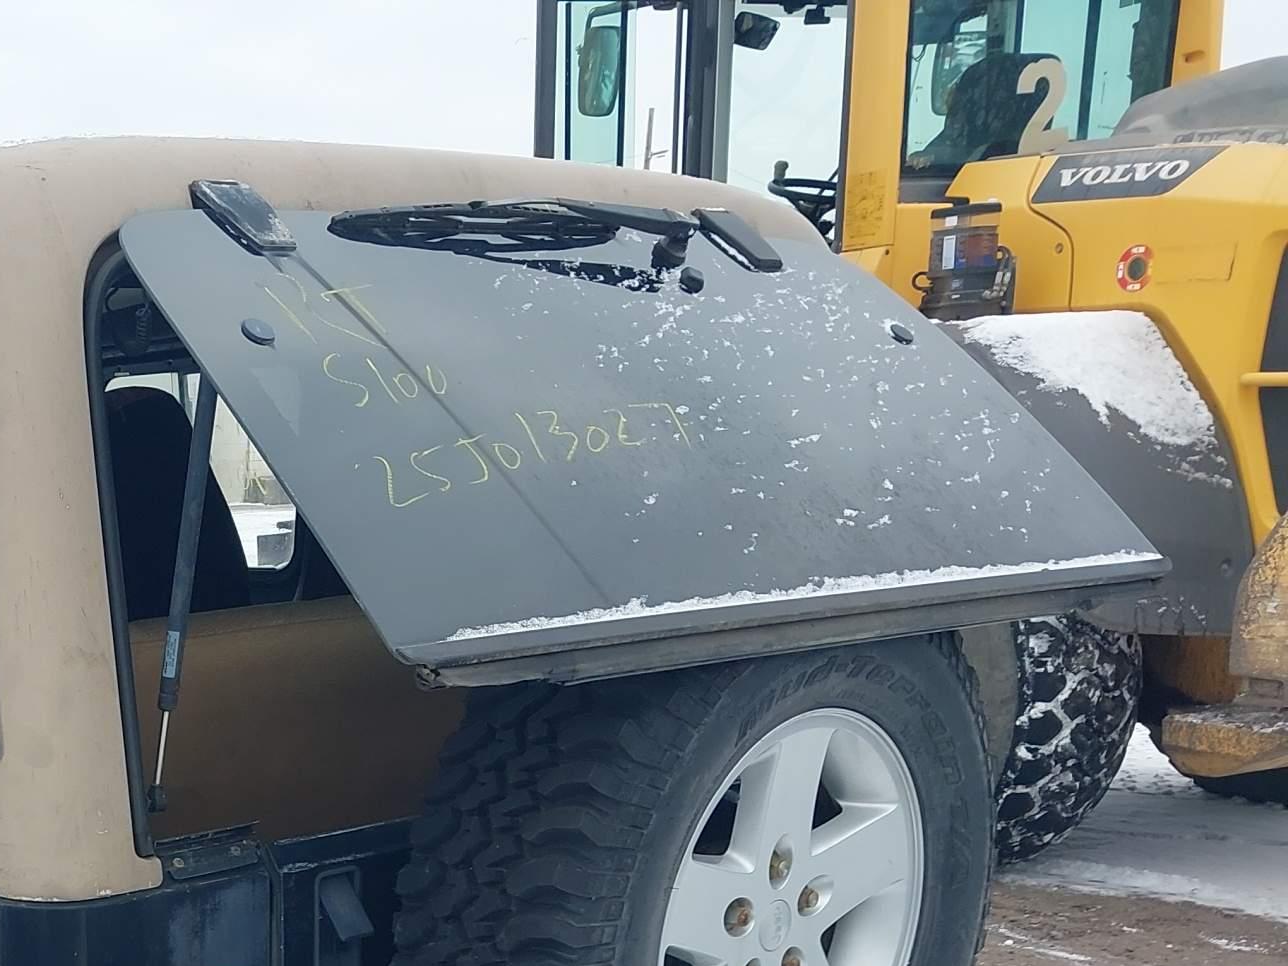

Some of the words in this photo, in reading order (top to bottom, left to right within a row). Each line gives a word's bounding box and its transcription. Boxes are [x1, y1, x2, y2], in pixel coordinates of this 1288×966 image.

[1017, 57, 1069, 155] 2
[1059, 160, 1190, 187] VOLVO
[372, 402, 692, 508] 25J013027
